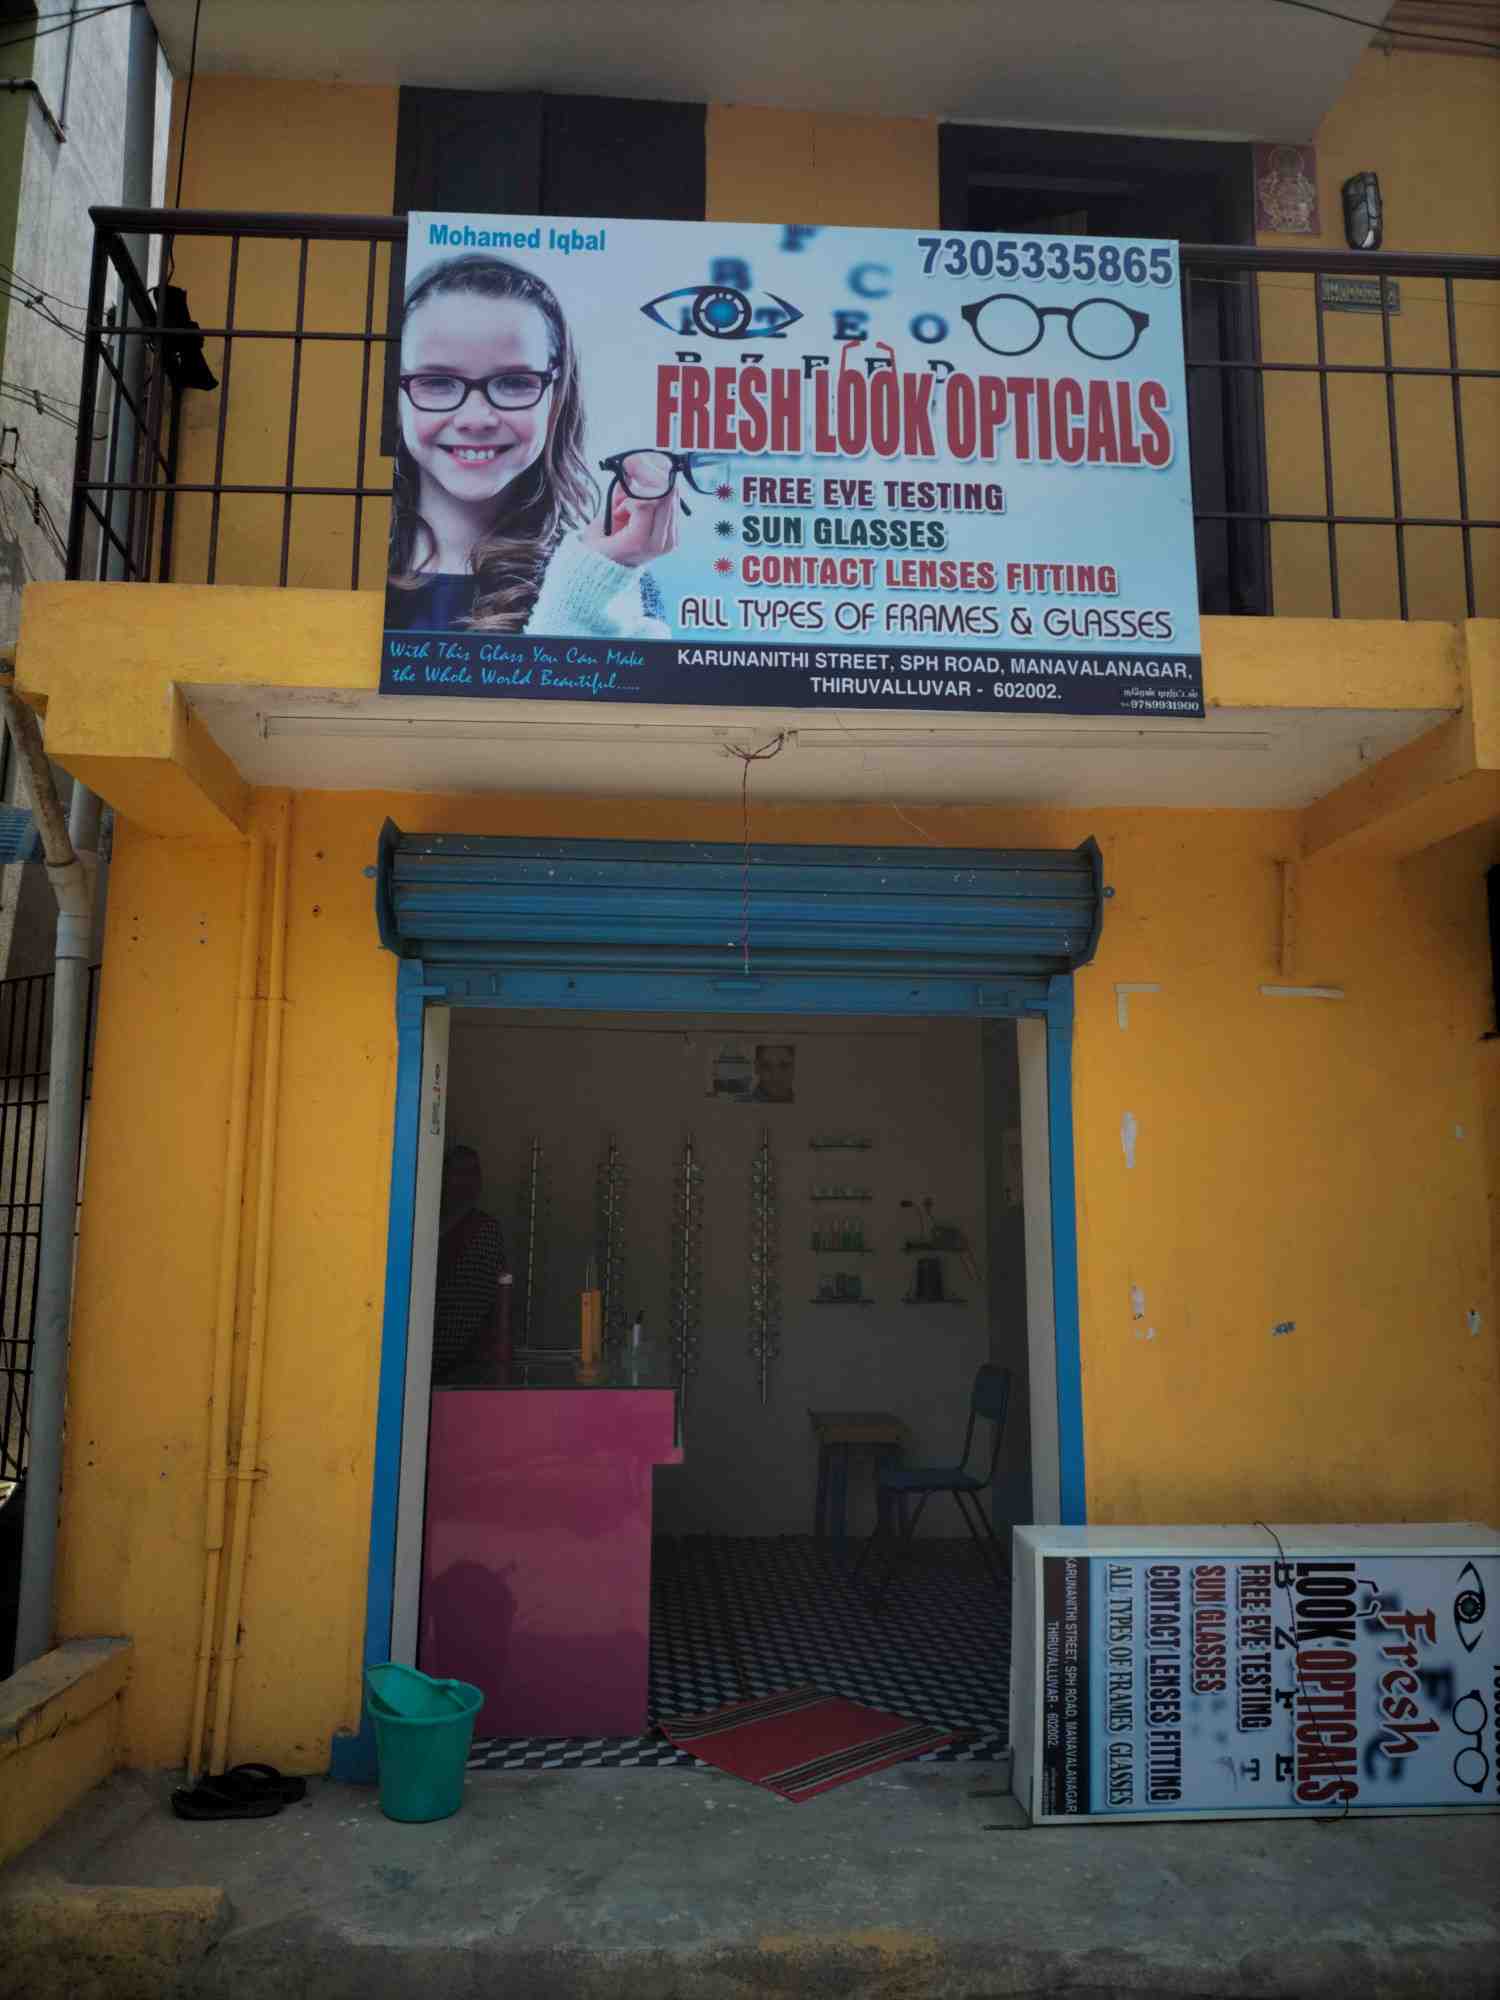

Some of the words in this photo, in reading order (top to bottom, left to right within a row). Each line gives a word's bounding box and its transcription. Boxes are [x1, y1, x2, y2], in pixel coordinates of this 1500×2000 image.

[429, 224, 540, 250] Mohamed
[548, 228, 607, 255] Iqbal
[917, 237, 1173, 284] 7305335865
[656, 364, 801, 452] FRESH
[815, 368, 936, 457] LOOK
[945, 372, 1172, 466] OPTICALS
[741, 477, 813, 505] FREE
[823, 479, 873, 507] EYE
[883, 481, 1004, 511] TESTING
[741, 515, 802, 545] SUN
[814, 518, 946, 548] GLASSES
[741, 555, 875, 586] CONTACT
[885, 559, 995, 589] LENSES
[1006, 563, 1117, 593] FITTING
[681, 597, 729, 627] ALL
[738, 599, 824, 629] TYPES
[835, 601, 875, 631] OF
[885, 603, 999, 634] FRAMES
[1010, 607, 1032, 635] &
[1043, 607, 1173, 639] GLASSES
[389, 640, 430, 658] With
[438, 642, 471, 661] This
[479, 644, 525, 664] Glass
[532, 645, 559, 665] You
[565, 647, 598, 665] Can
[605, 648, 645, 666] Make
[677, 648, 809, 669] KARUNANITHI
[900, 655, 938, 672] SPH
[392, 666, 416, 682] the
[425, 665, 473, 684] Whole
[481, 667, 531, 686] World
[810, 676, 972, 697] THIRUVALLUVAR
[1109, 1564, 1133, 1593] ALL
[1195, 1565, 1227, 1606] SUN
[1241, 1564, 1272, 1608] FREE
[1109, 1597, 1133, 1642] TYPES
[1150, 1564, 1181, 1648] CONTACT
[1295, 1562, 1357, 1641] LOOK
[1195, 1609, 1227, 1693] GLASSES
[1241, 1615, 1272, 1649] EYE
[1109, 1646, 1133, 1666] OF
[1109, 1671, 1133, 1732] FRAMES
[1150, 1655, 1181, 1724] LENSES
[1241, 1652, 1272, 1729] TESTING
[1382, 1608, 1441, 1753] Fresh
[1295, 1650, 1359, 1801] OPTICALS
[1109, 1742, 1133, 1806] GLASSES
[1150, 1730, 1182, 1801] FITTING
